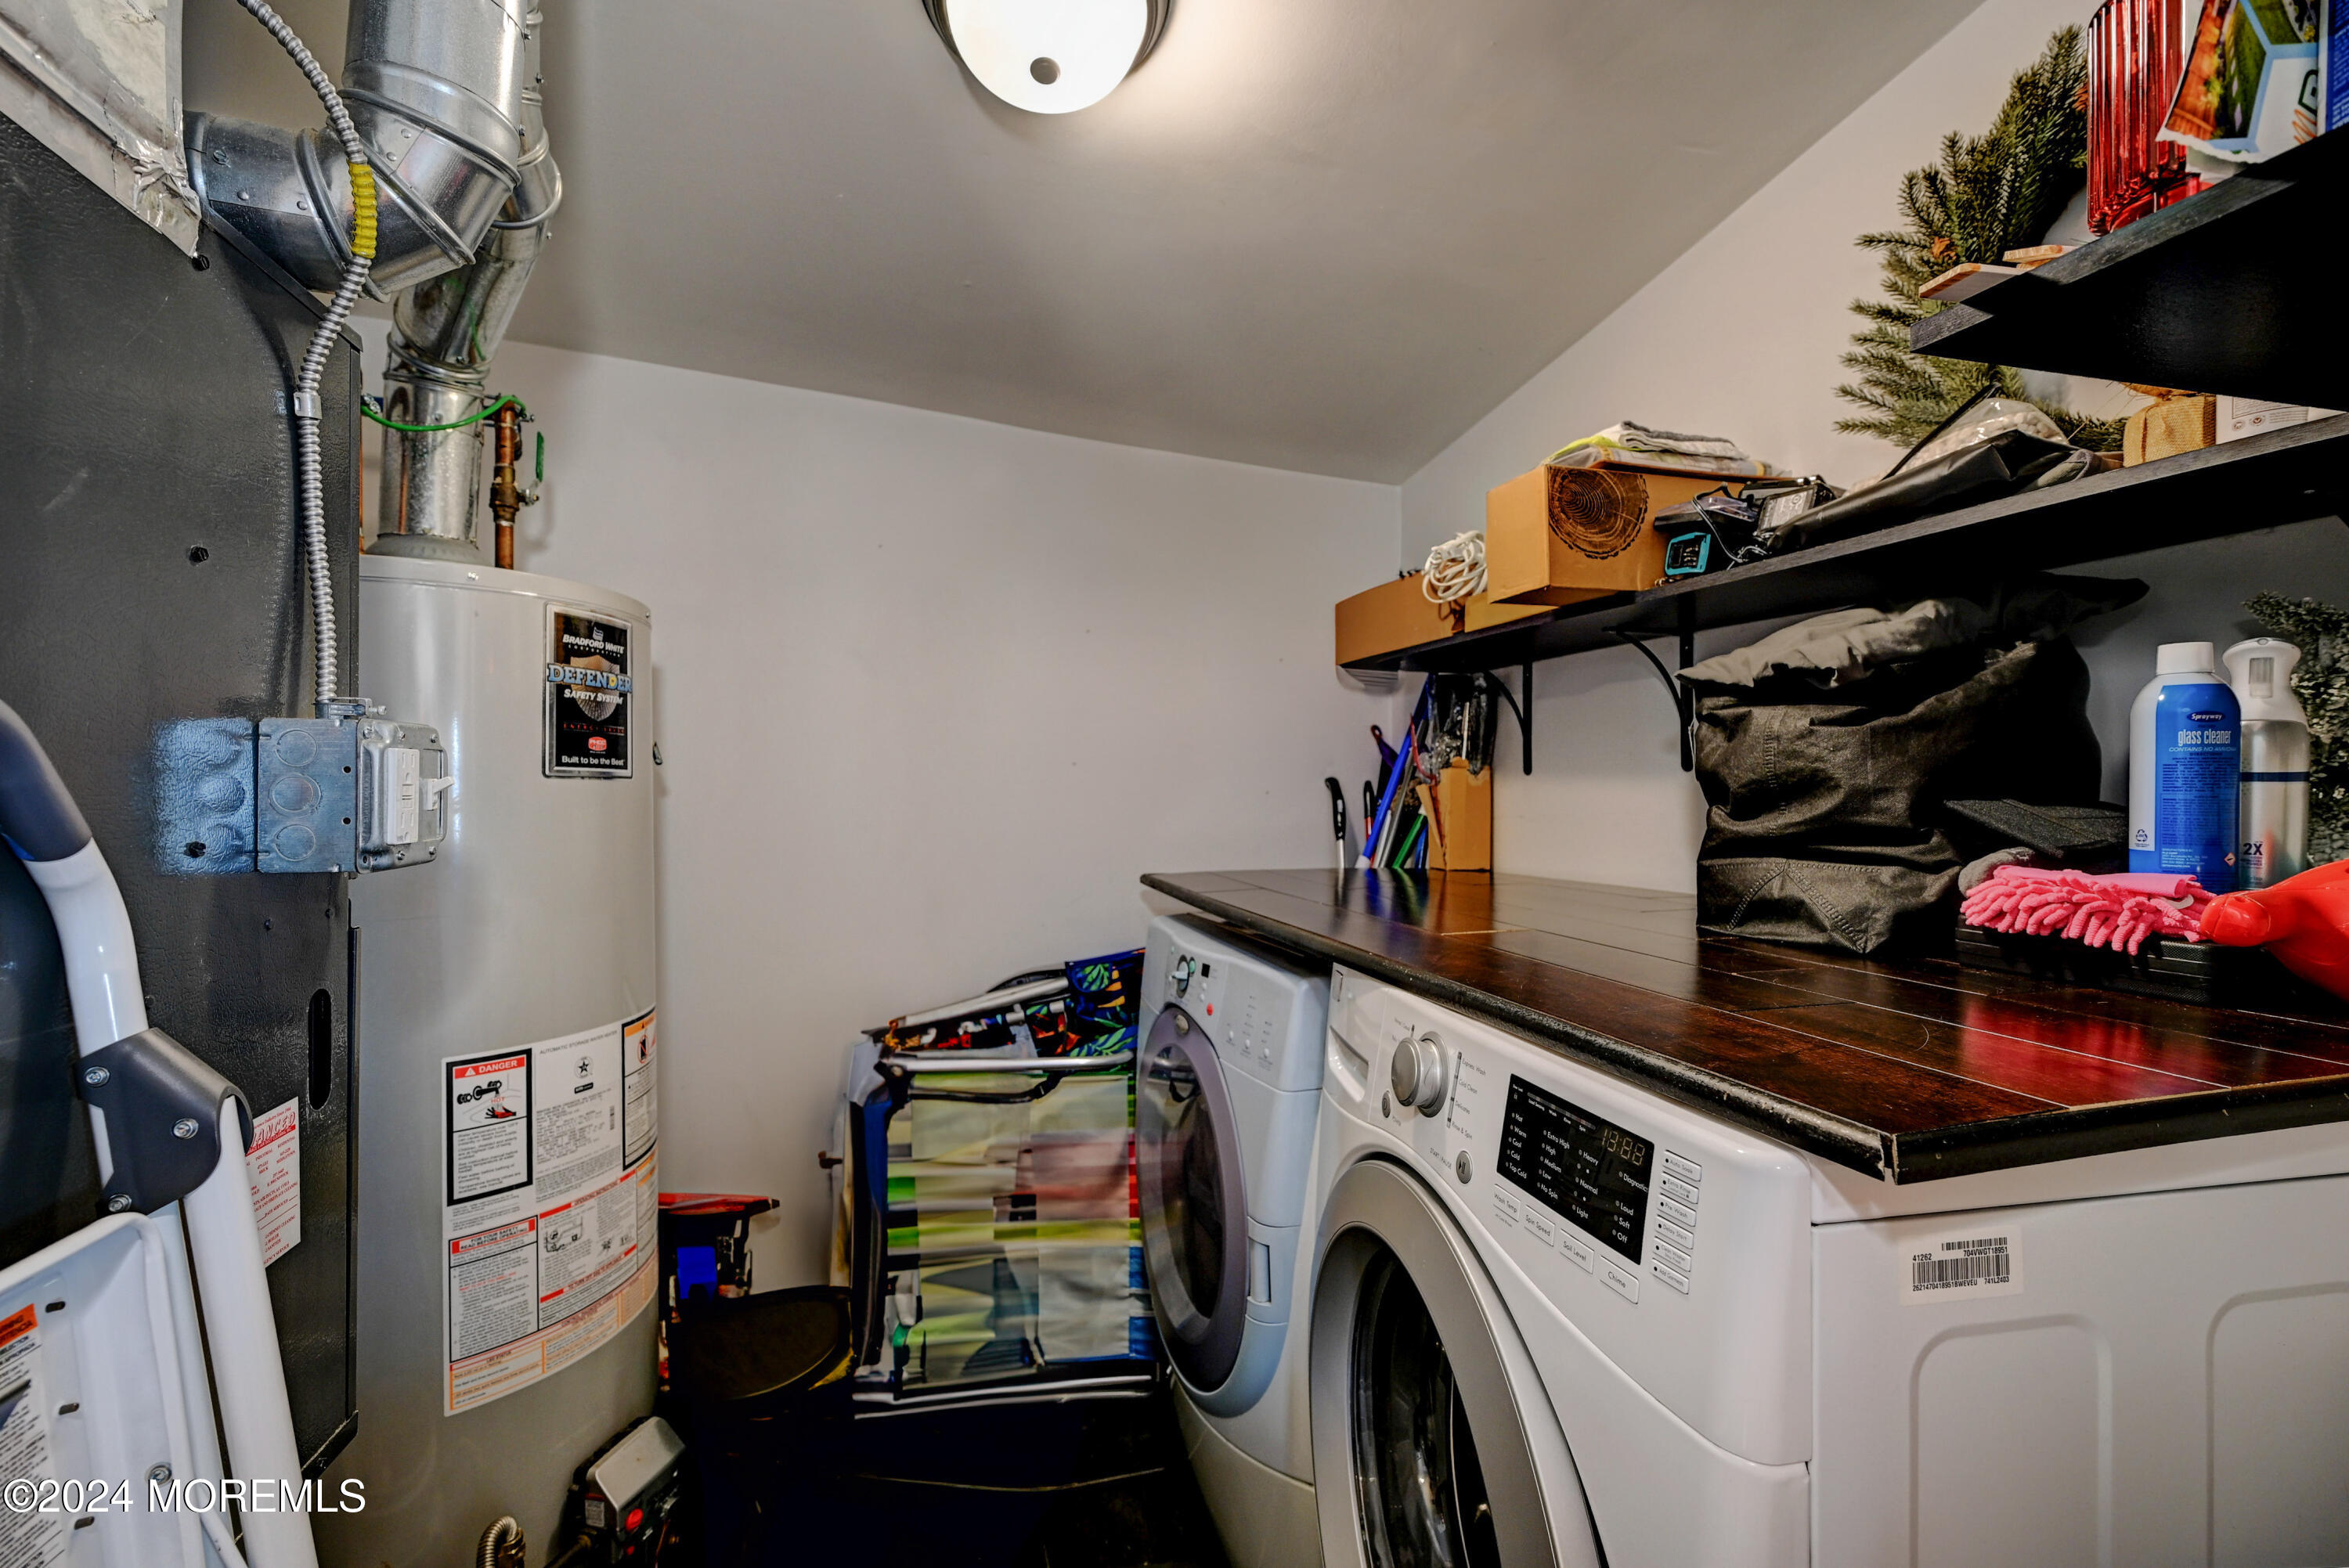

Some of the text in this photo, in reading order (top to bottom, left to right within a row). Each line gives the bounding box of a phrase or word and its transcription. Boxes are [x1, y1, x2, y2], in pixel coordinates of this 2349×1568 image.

[563, 634, 625, 654] BRADFORD WHITE
[547, 663, 633, 694] DEFENDER
[564, 689, 624, 705] SAFETY SYSTEM
[2178, 729, 2231, 746] glass cleaner
[2243, 842, 2263, 856] 2X
[478, 1060, 518, 1073] DANGER
[1514, 1126, 1527, 1138] Warm
[1513, 1137, 1522, 1148] Cool
[1547, 1131, 1570, 1149] Extra High
[1510, 1150, 1520, 1161] Cold
[1546, 1144, 1556, 1155] High
[1544, 1158, 1562, 1173] Medium
[1583, 1151, 1598, 1166] Heavy
[1517, 1168, 1527, 1179] Cold
[1543, 1170, 1552, 1181] Low
[1541, 1184, 1558, 1200] No Spin
[1580, 1179, 1598, 1195] Normal
[1494, 1193, 1517, 1214] Wash Temp
[1620, 1202, 1634, 1216] Loud
[1577, 1206, 1588, 1219] Light
[1525, 1215, 1535, 1226] Spin
[1536, 1222, 1550, 1237] Speed
[1619, 1217, 1630, 1229] Soft
[1617, 1232, 1627, 1243] Off
[1563, 1241, 1586, 1261] Soil Level
[1913, 1253, 1932, 1262] 41262
[1607, 1271, 1626, 1289] Chime
